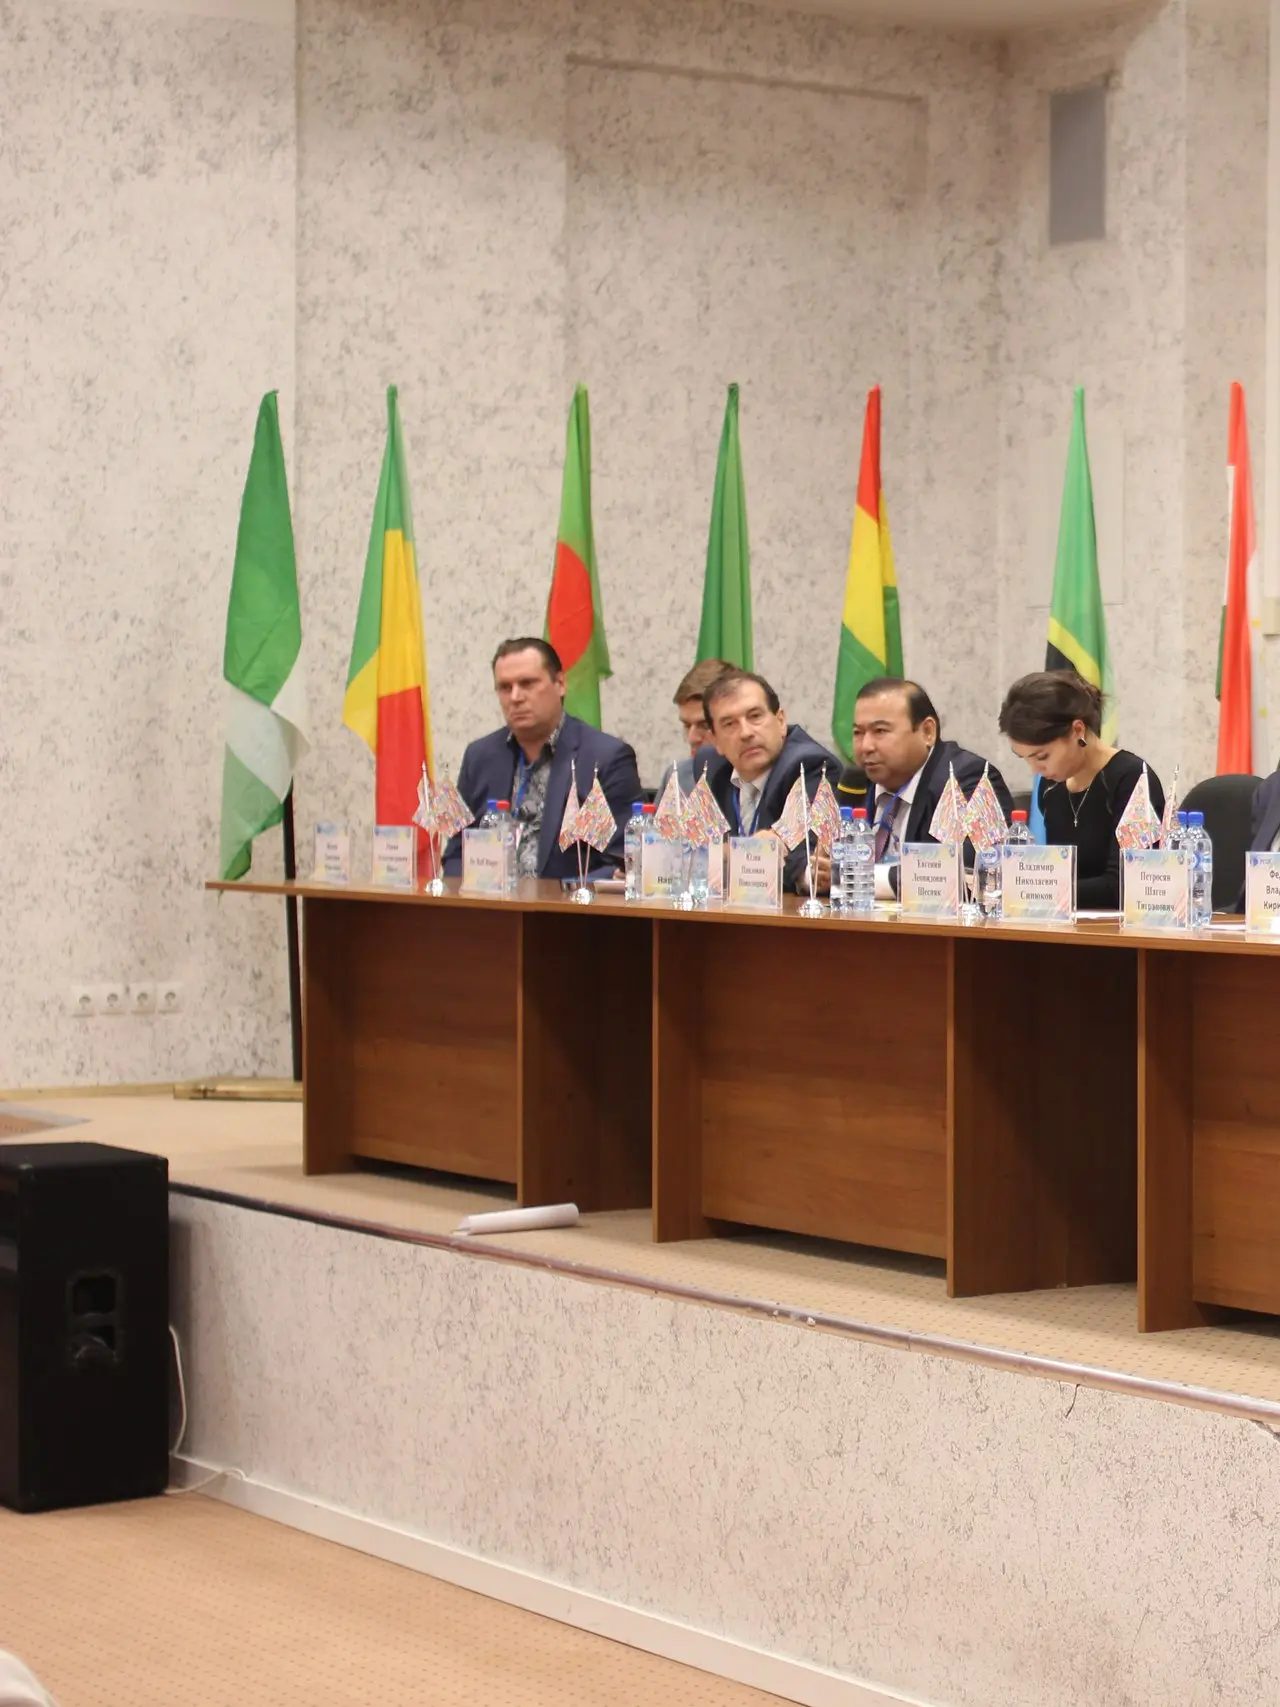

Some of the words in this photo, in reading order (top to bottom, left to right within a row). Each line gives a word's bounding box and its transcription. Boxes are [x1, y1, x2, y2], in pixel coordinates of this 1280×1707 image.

[1019, 862, 1054, 873] Владимир
[1015, 877, 1058, 886] Николаевич
[1140, 871, 1171, 883] Петросян
